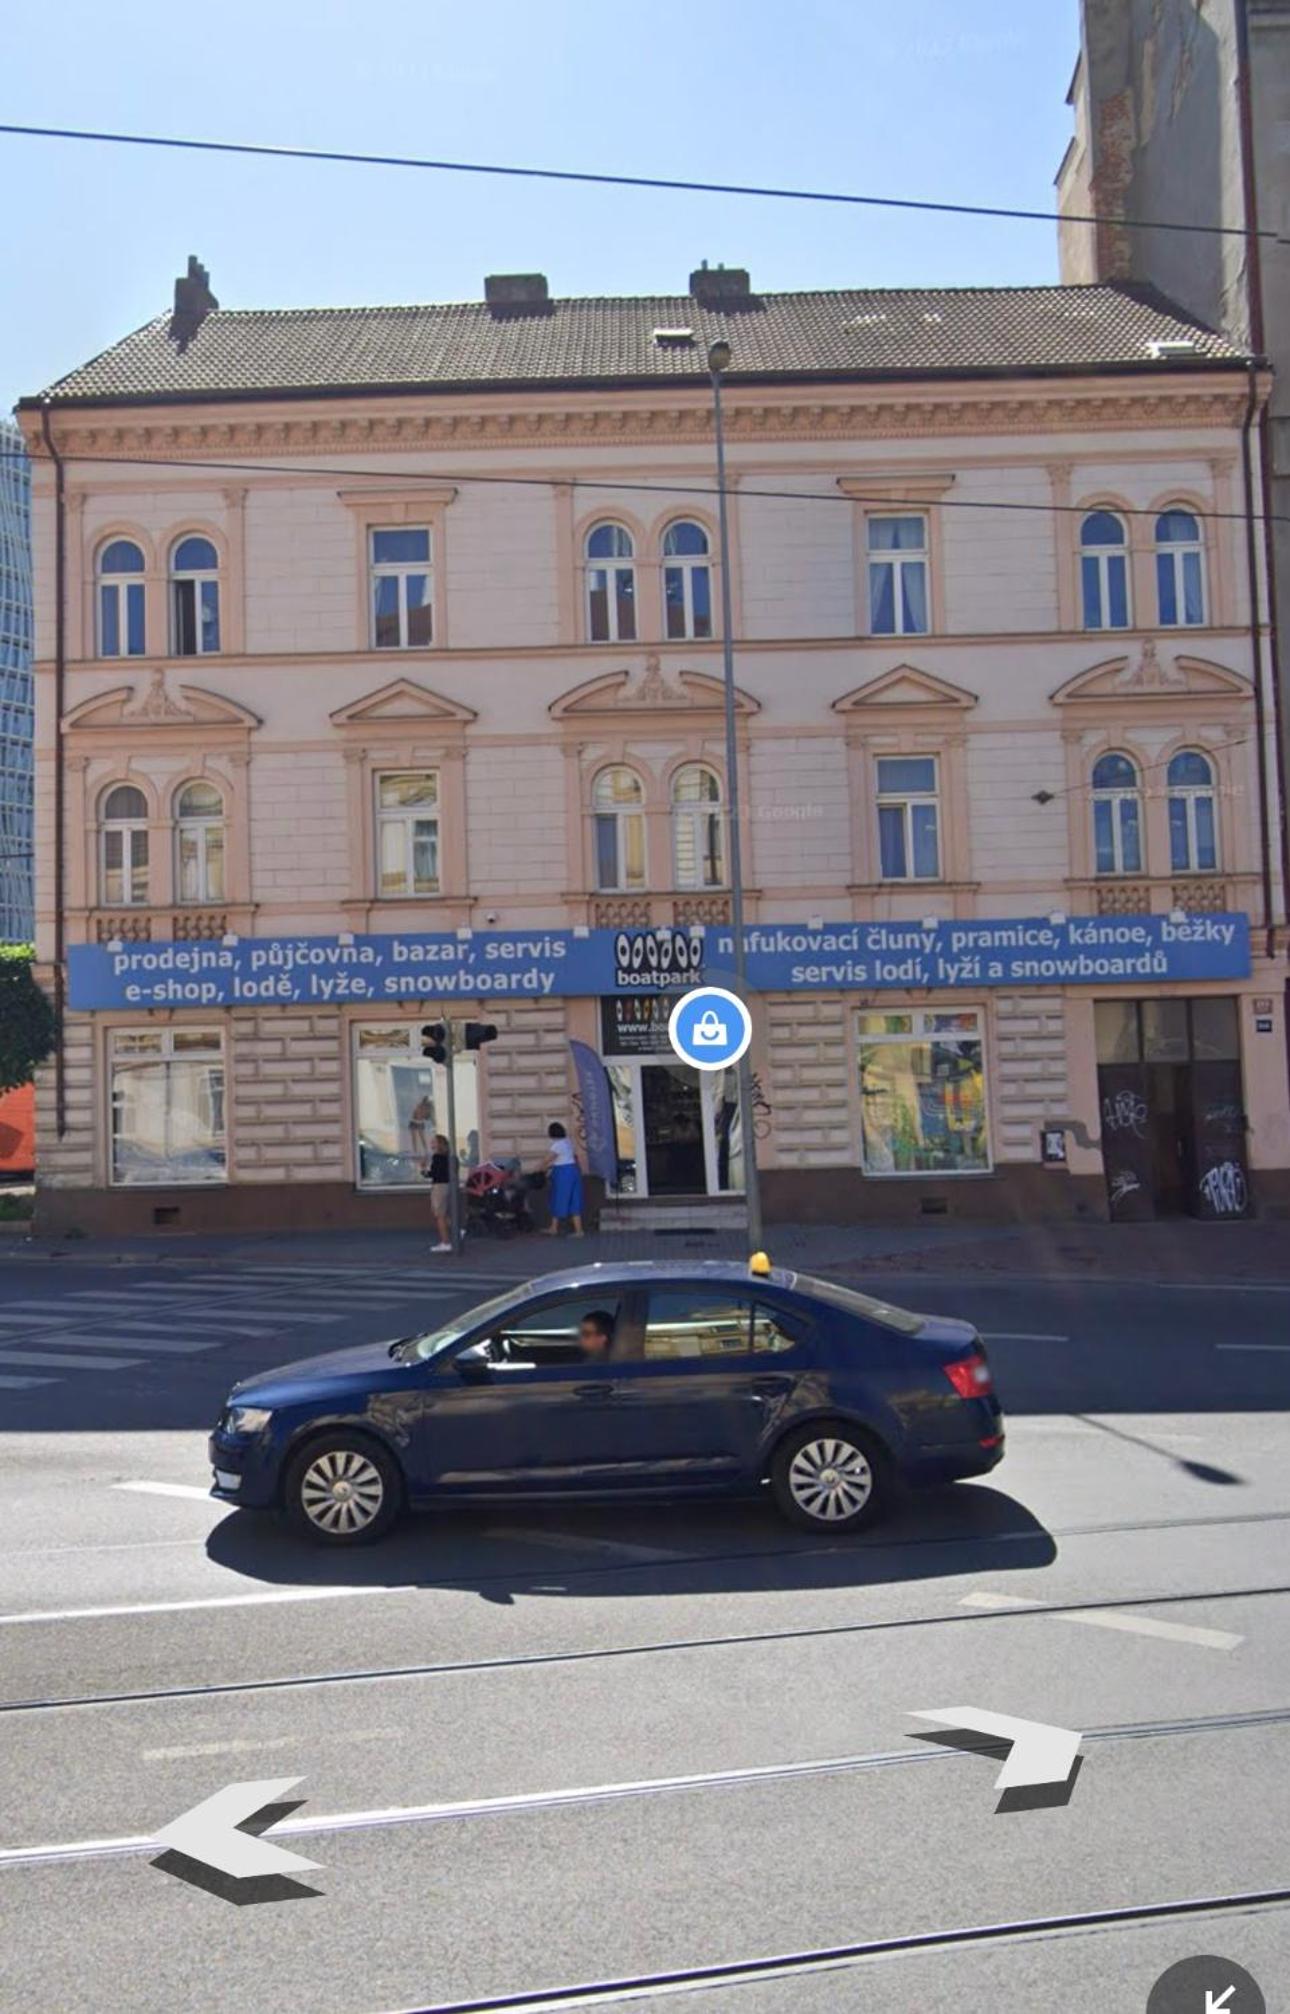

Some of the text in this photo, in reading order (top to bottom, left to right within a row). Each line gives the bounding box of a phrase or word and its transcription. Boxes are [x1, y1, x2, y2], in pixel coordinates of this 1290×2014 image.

[867, 927, 942, 953] čluny,
[952, 925, 1059, 953] pramice,
[1069, 922, 1153, 947] kánoe,
[1161, 917, 1236, 945] běžky
[114, 938, 566, 974] prodejna, půjčovna, bazar, servis
[791, 950, 1168, 984] servis lodí, lyží a snowboardů
[126, 968, 555, 1002] e-shop, lodě, lyže, snowboardy
[617, 967, 701, 988] boatpark
